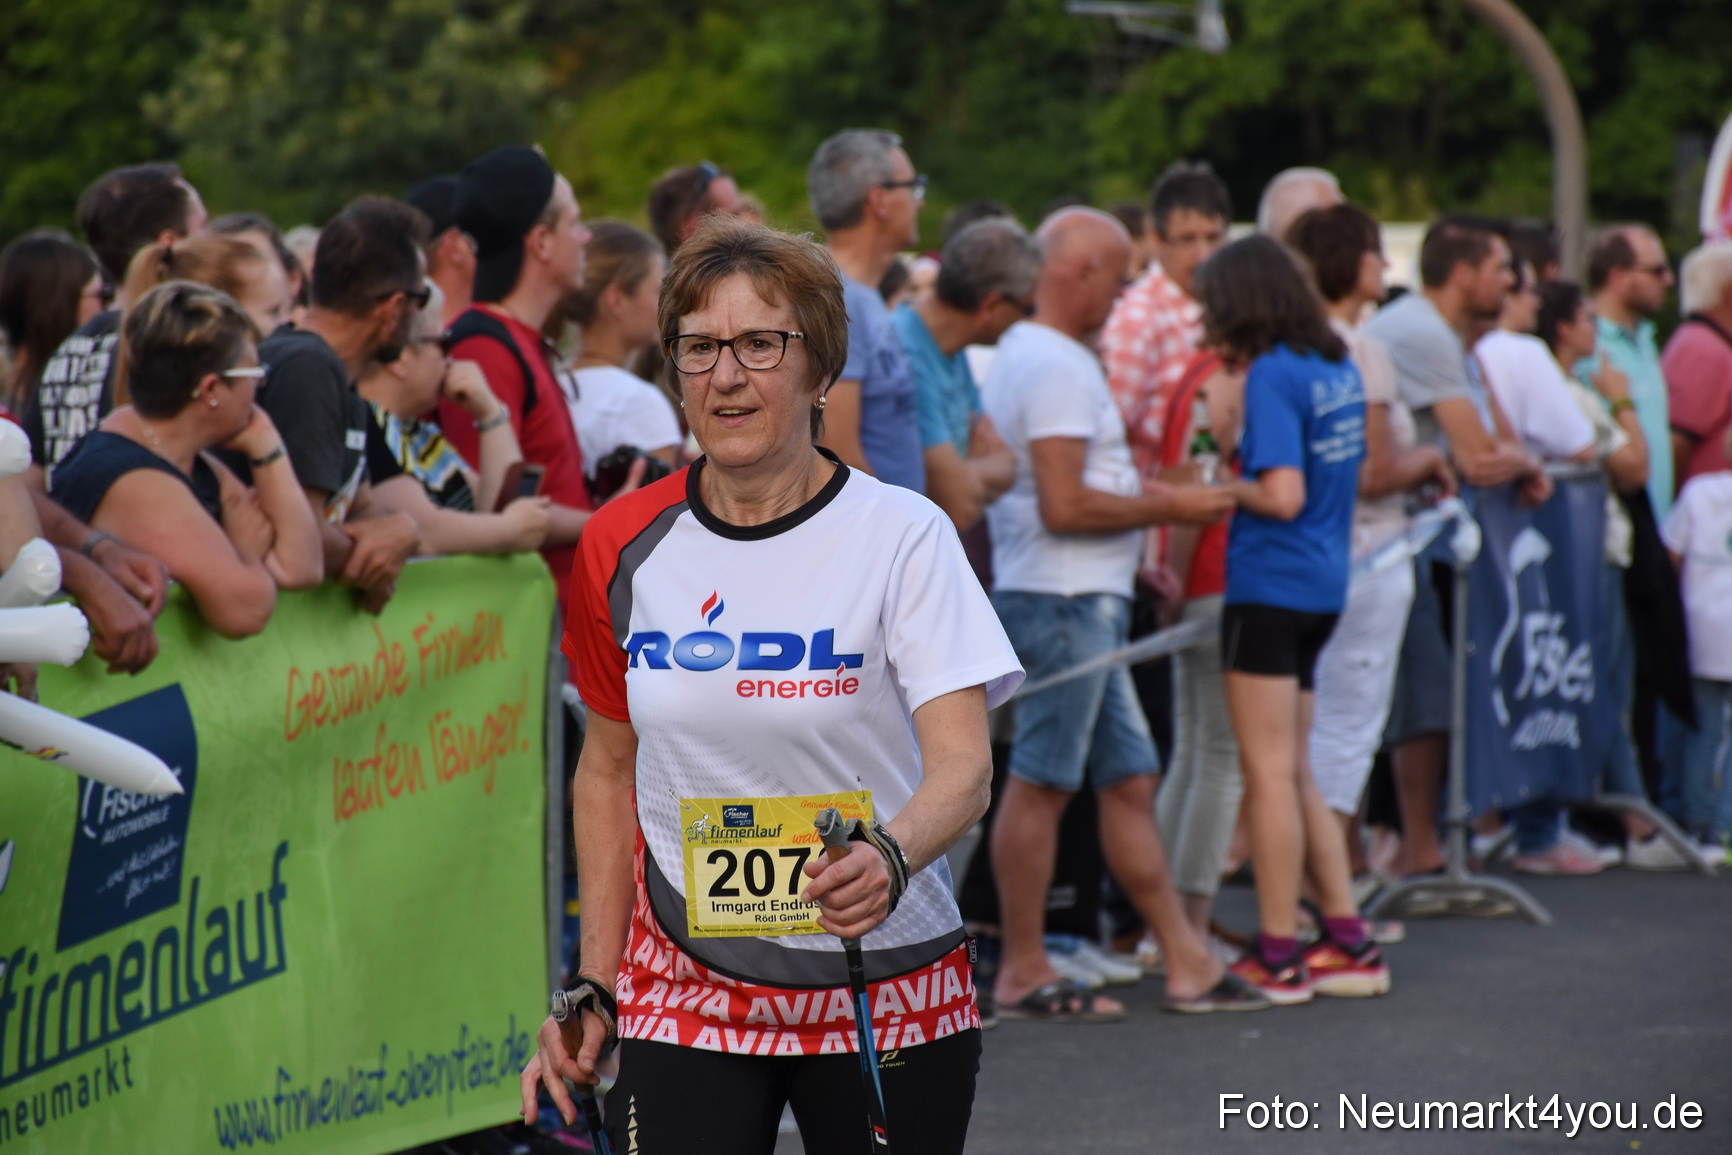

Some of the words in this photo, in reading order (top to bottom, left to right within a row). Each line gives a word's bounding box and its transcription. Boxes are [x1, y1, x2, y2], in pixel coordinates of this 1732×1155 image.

[284, 621, 411, 742] Gesunde
[412, 612, 508, 690] Firmen
[736, 677, 859, 699] energie
[332, 722, 427, 824] laufen
[428, 671, 530, 795] länger!
[710, 824, 783, 838] firmenlauf
[706, 847, 827, 898] 207
[712, 900, 766, 914] Irmgard
[755, 914, 777, 923] Rödl
[779, 912, 810, 922] GmbH
[0, 840, 289, 1085] firmenlauf
[637, 979, 731, 1023] AVIA
[744, 988, 856, 1026] AVIA
[872, 961, 965, 1019] AVIA
[691, 1026, 805, 1056] AVIA
[0, 1046, 133, 1145] neumarkt
